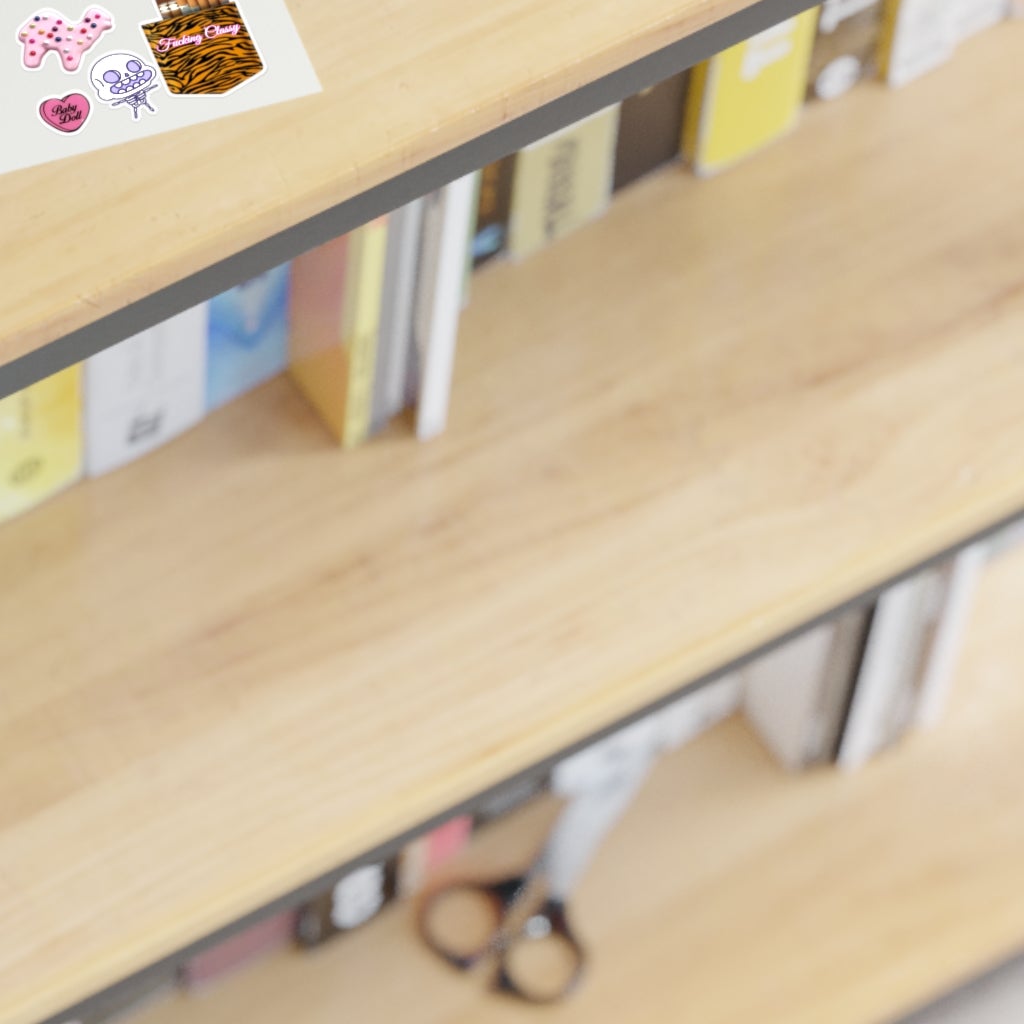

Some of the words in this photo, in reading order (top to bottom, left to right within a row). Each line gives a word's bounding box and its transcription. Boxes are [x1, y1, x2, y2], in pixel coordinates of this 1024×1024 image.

[156, 34, 203, 53] Fucking
[204, 23, 241, 39] Classy
[51, 103, 77, 117] Baby
[59, 110, 82, 125] Doll
